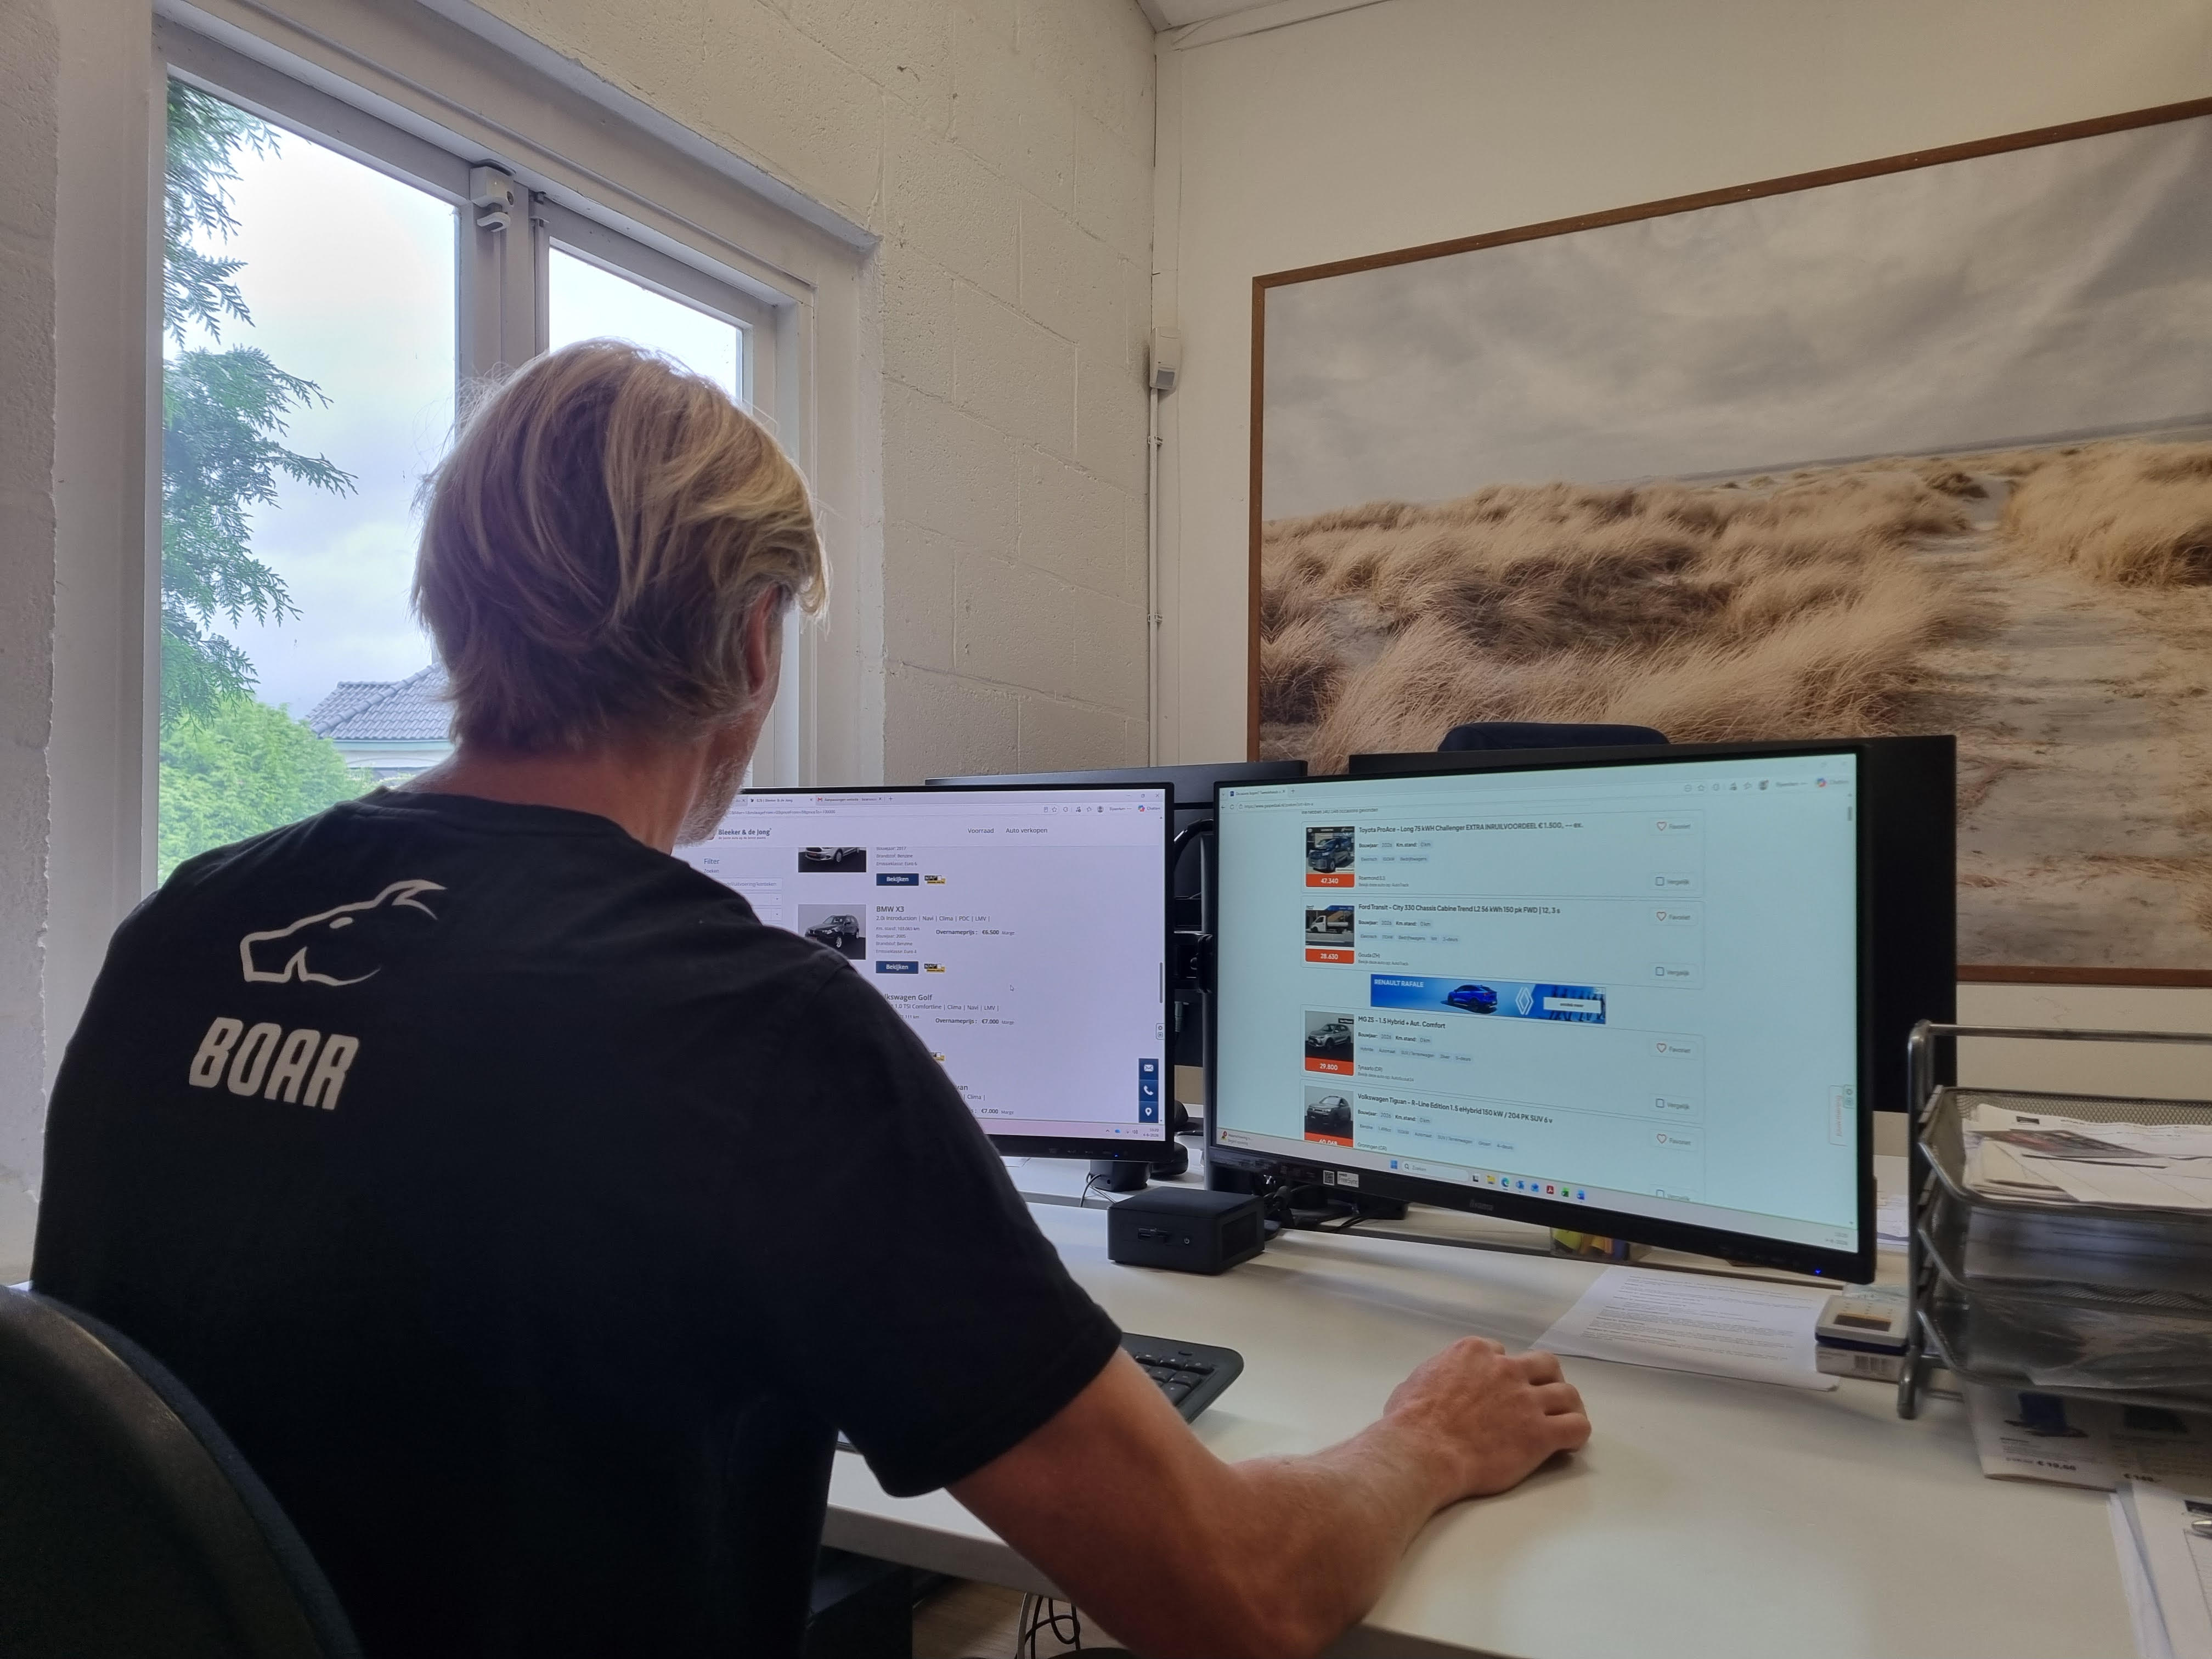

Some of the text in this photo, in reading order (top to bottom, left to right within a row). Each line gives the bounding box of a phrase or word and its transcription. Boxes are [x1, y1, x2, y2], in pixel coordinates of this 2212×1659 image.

[884, 994, 916, 1002] lkswagen
[189, 1017, 360, 1110] BOAR
[1319, 1063, 1338, 1071] 29.800
[1358, 1093, 1389, 1103] Volkswagen
[1411, 1100, 1430, 1108] R-Line
[1430, 1102, 1449, 1111] Edition
[1459, 1106, 1482, 1115] eHybrid
